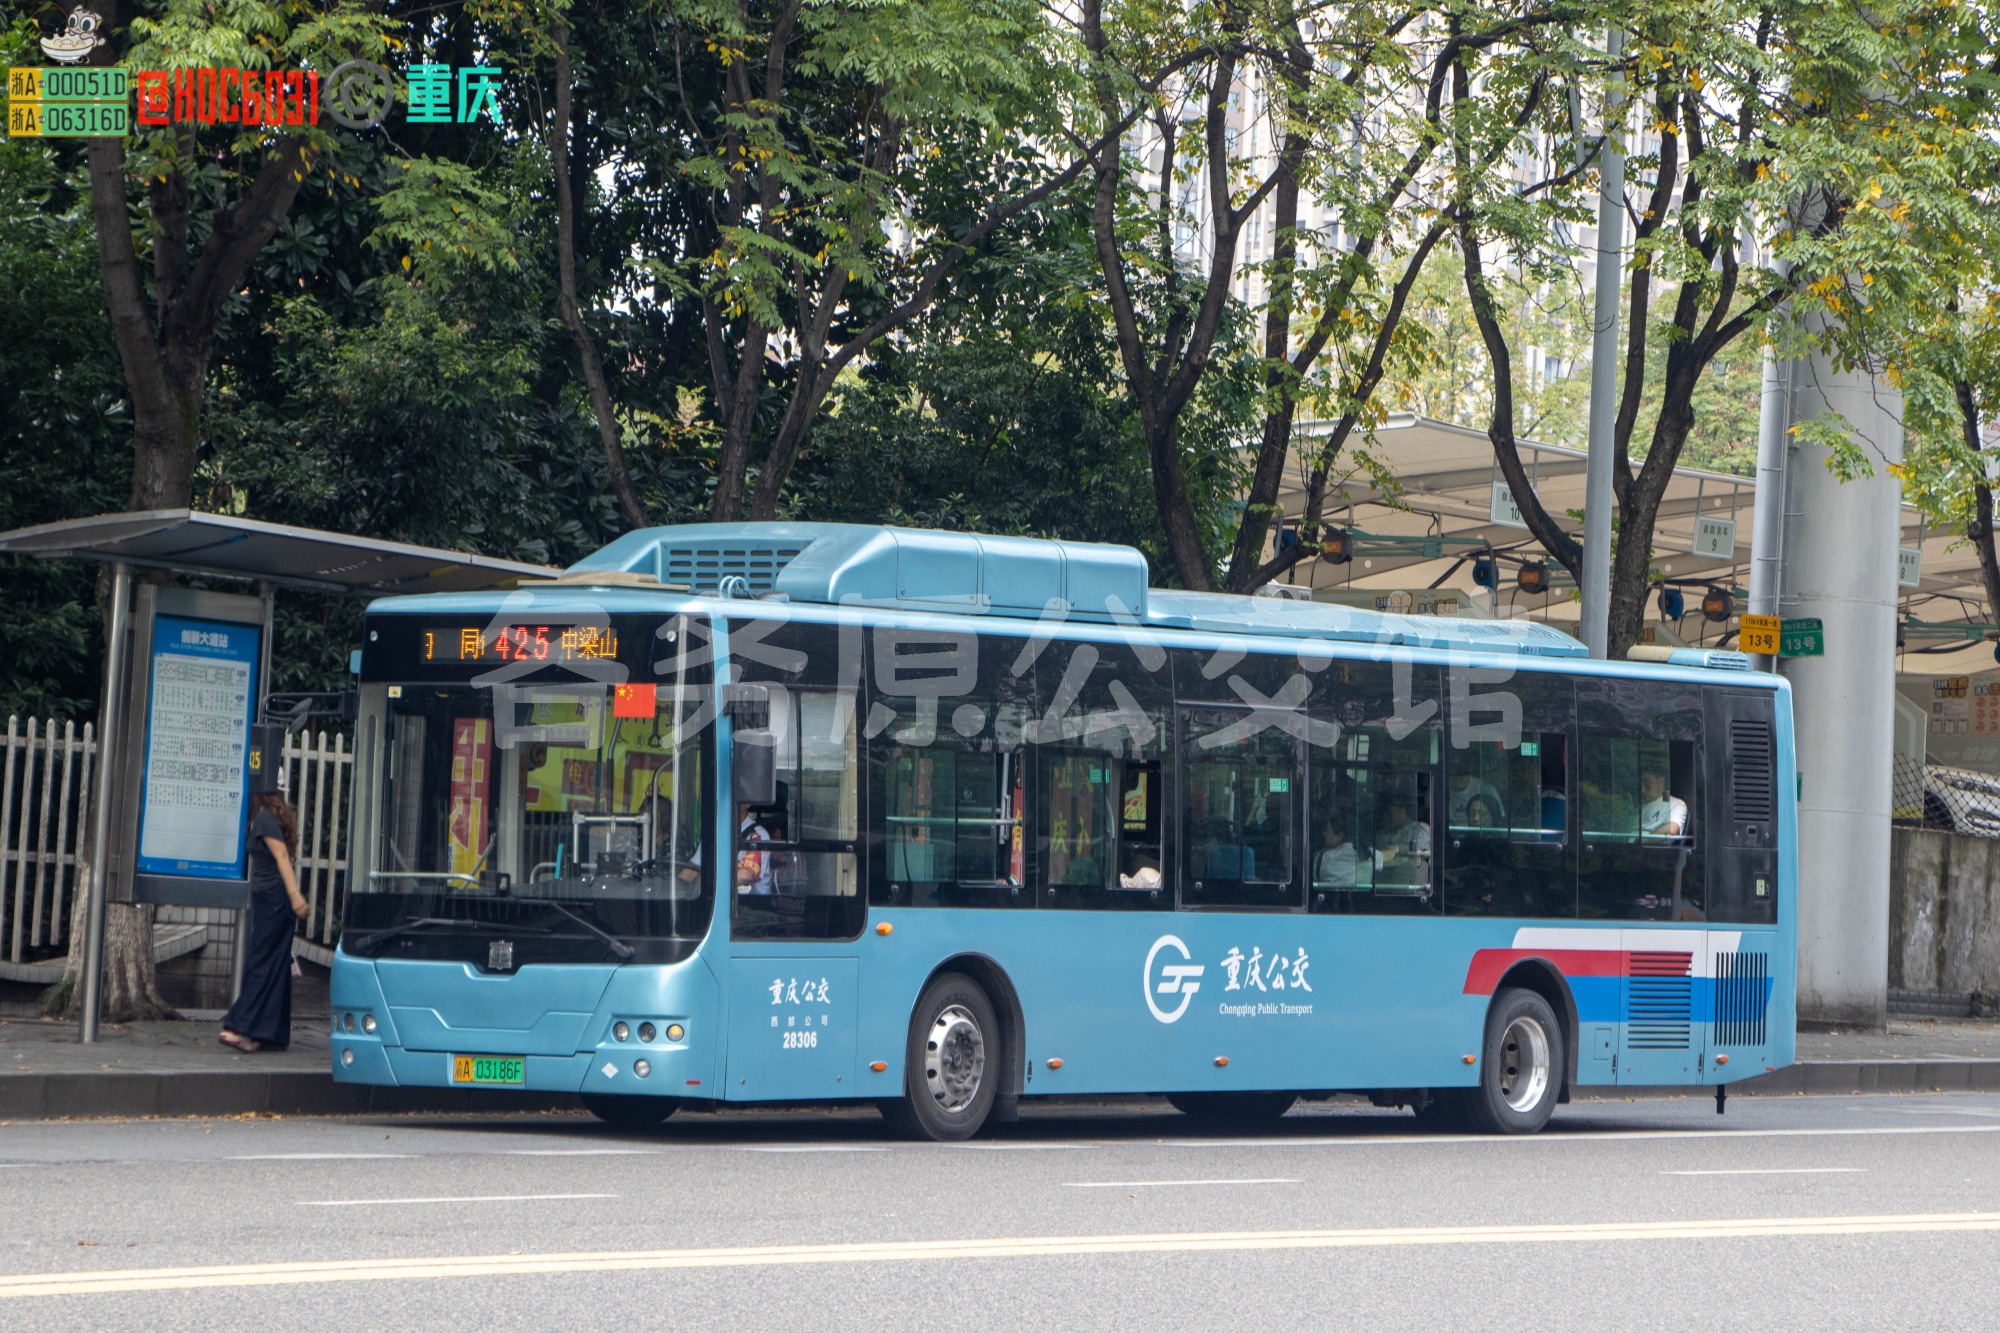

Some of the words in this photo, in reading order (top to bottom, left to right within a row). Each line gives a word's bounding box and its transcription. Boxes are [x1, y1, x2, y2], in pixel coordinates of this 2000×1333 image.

[1712, 538, 1717, 551] 9
[1901, 567, 1905, 579] 8
[494, 627, 549, 660] 425
[561, 627, 617, 660] 中梁山
[1749, 634, 1773, 648] 13号
[1786, 636, 1816, 650] 13号
[1220, 946, 1313, 992] 重庆公交
[768, 977, 831, 1005] 重庆公交
[1219, 1003, 1256, 1017] Chongqing
[1257, 1002, 1279, 1014] Public
[1280, 1003, 1313, 1017] Transport
[783, 1031, 817, 1049] 28306
